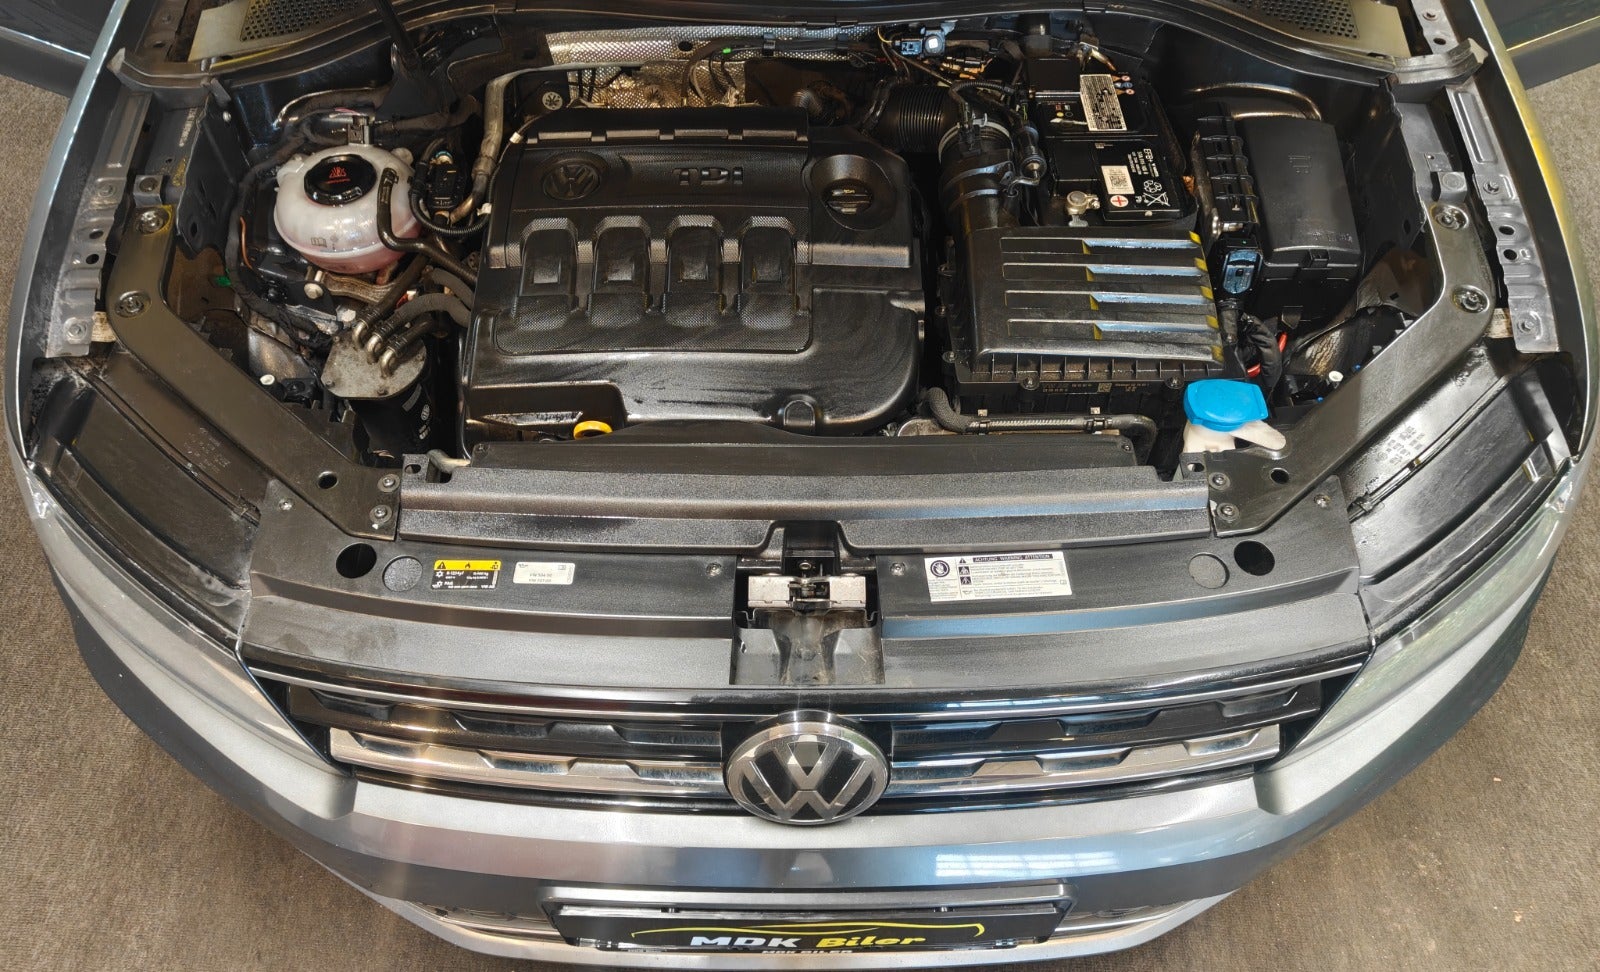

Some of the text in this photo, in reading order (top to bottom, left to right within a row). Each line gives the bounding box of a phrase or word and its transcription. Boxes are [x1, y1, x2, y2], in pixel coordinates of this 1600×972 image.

[672, 166, 744, 186] TDI
[690, 935, 927, 949] MDK Biler
